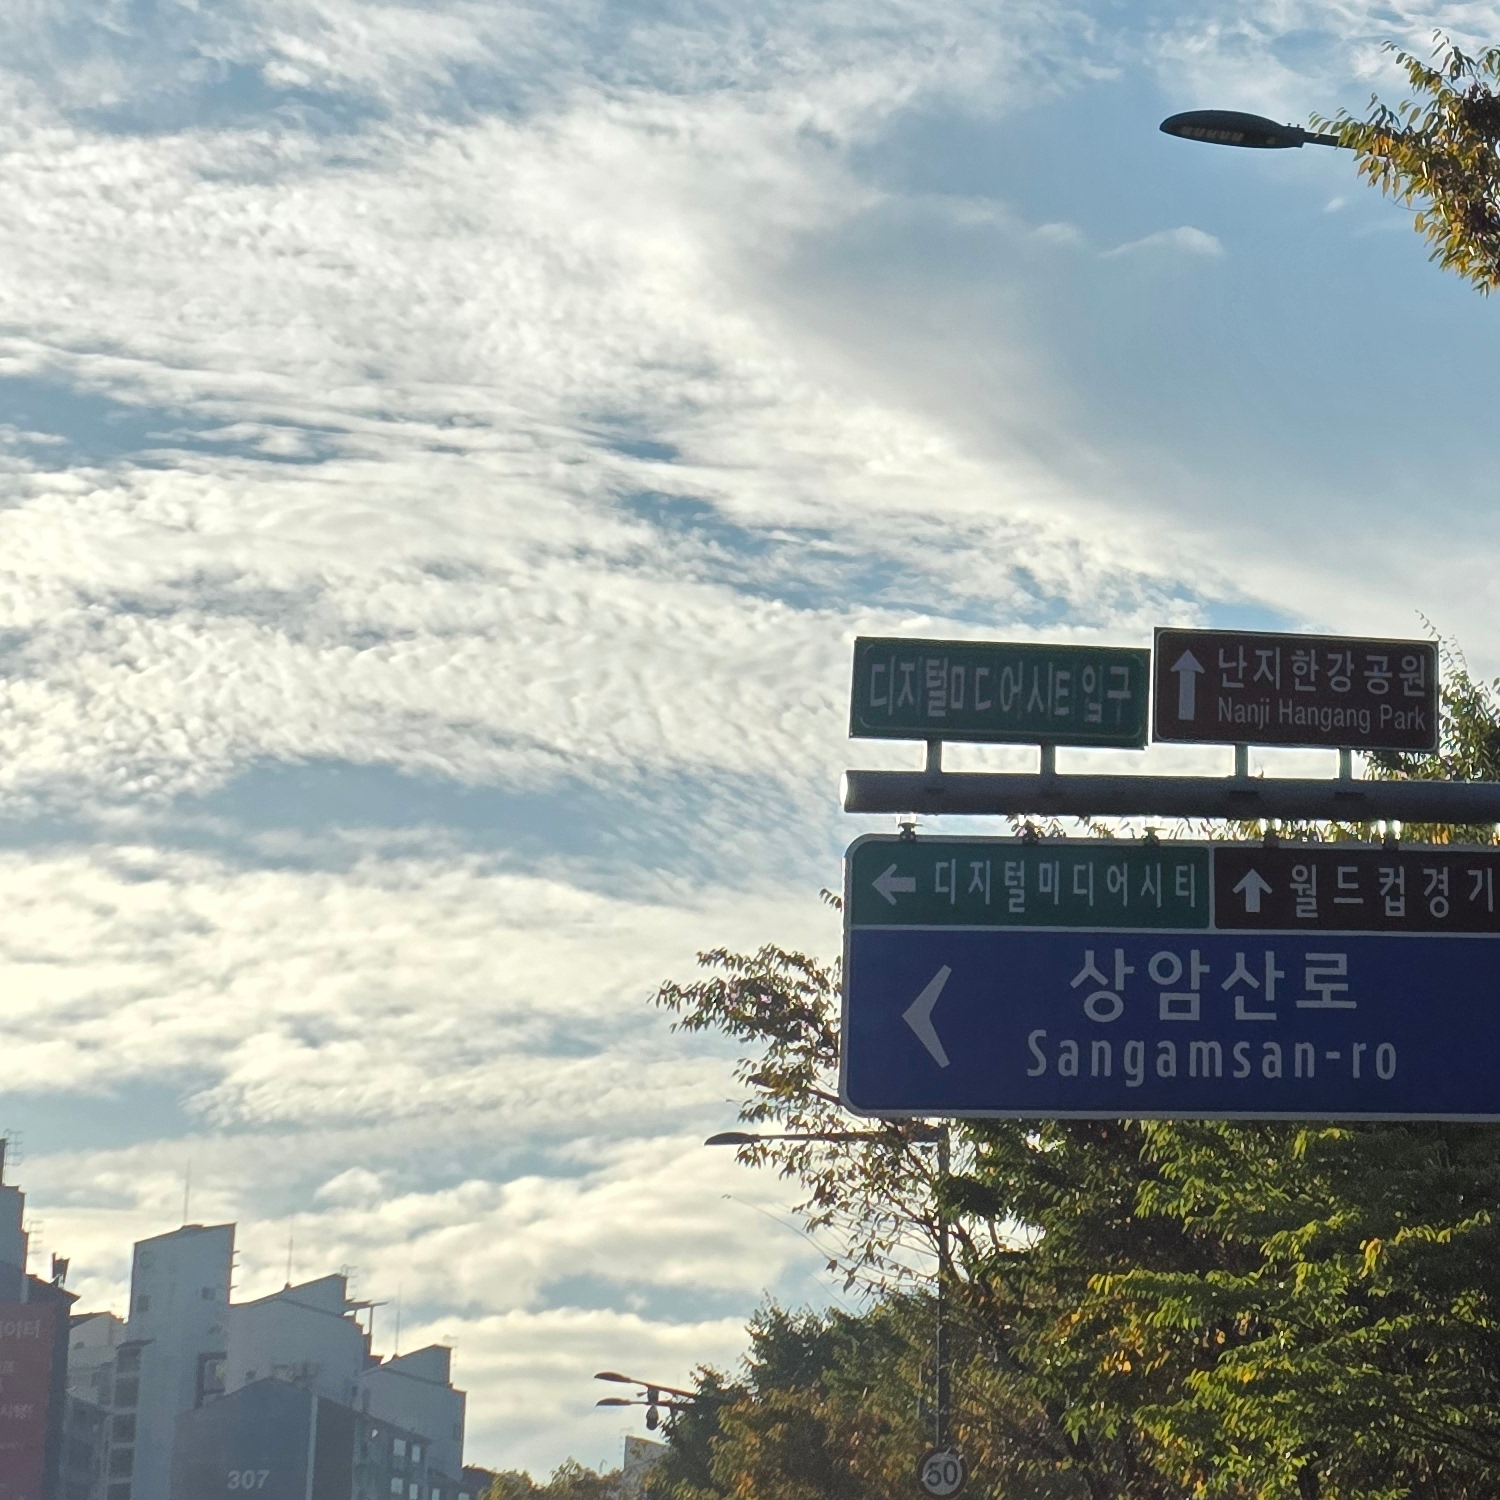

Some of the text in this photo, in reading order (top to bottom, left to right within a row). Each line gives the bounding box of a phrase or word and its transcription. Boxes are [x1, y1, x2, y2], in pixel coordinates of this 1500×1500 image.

[1217, 644, 1426, 698] 난지한강공원
[1217, 696, 1427, 735] Nanji Hangang Park
[934, 858, 1196, 913] 디지털미디어시티
[1069, 948, 1358, 1023] 상암산로
[1026, 1028, 1398, 1088] Sangamsan-ro
[227, 1469, 271, 1491] 307
[927, 1461, 957, 1486] 50
